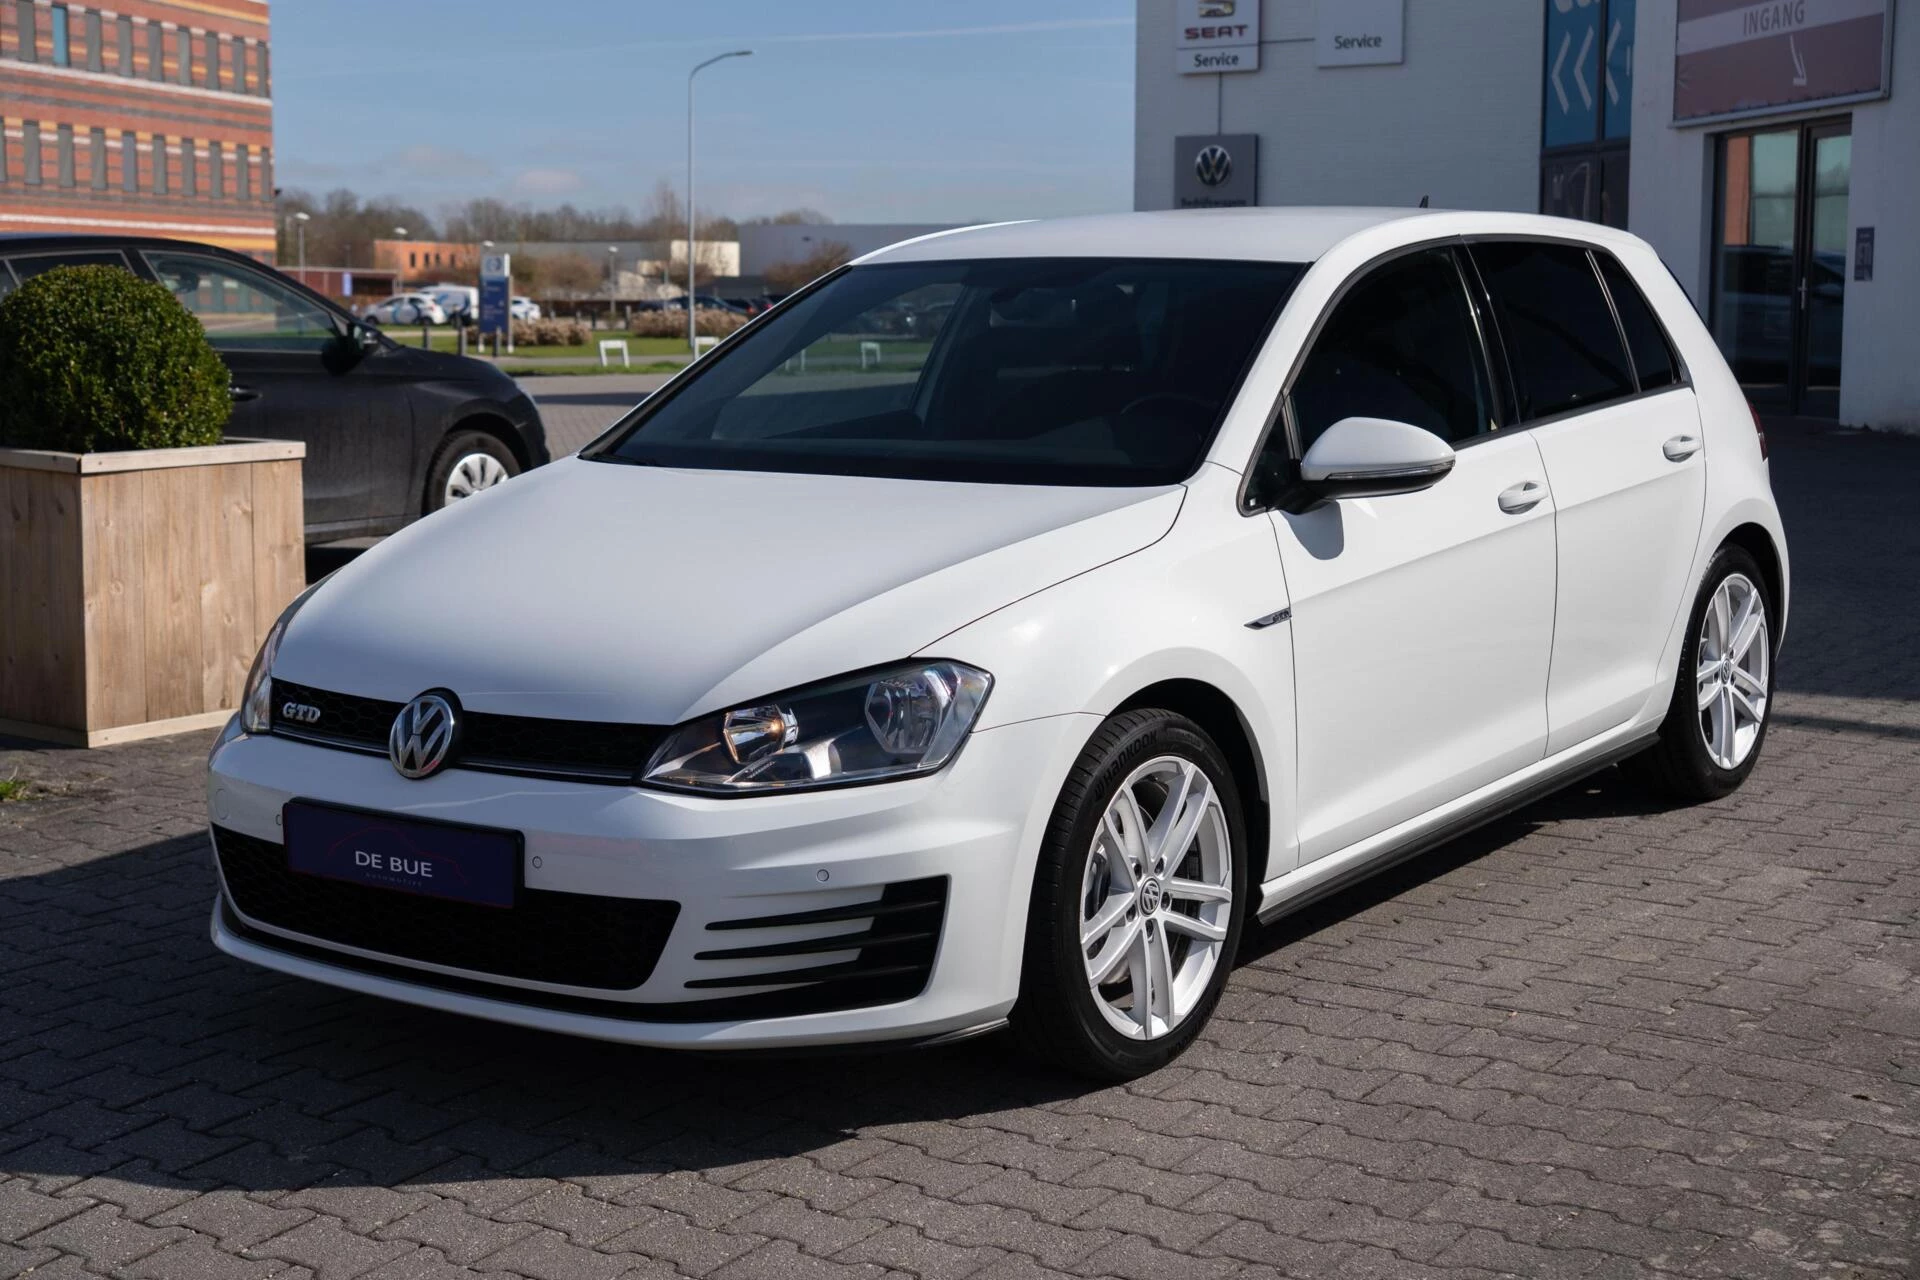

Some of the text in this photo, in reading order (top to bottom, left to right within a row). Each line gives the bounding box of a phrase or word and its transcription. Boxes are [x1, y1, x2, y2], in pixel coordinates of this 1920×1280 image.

[1743, 1, 1805, 36] INGANG
[1184, 24, 1248, 40] SEAT
[1334, 34, 1382, 49] Service
[1194, 52, 1239, 68] Service
[282, 701, 321, 723] GTD
[355, 850, 433, 879] DE BUE
